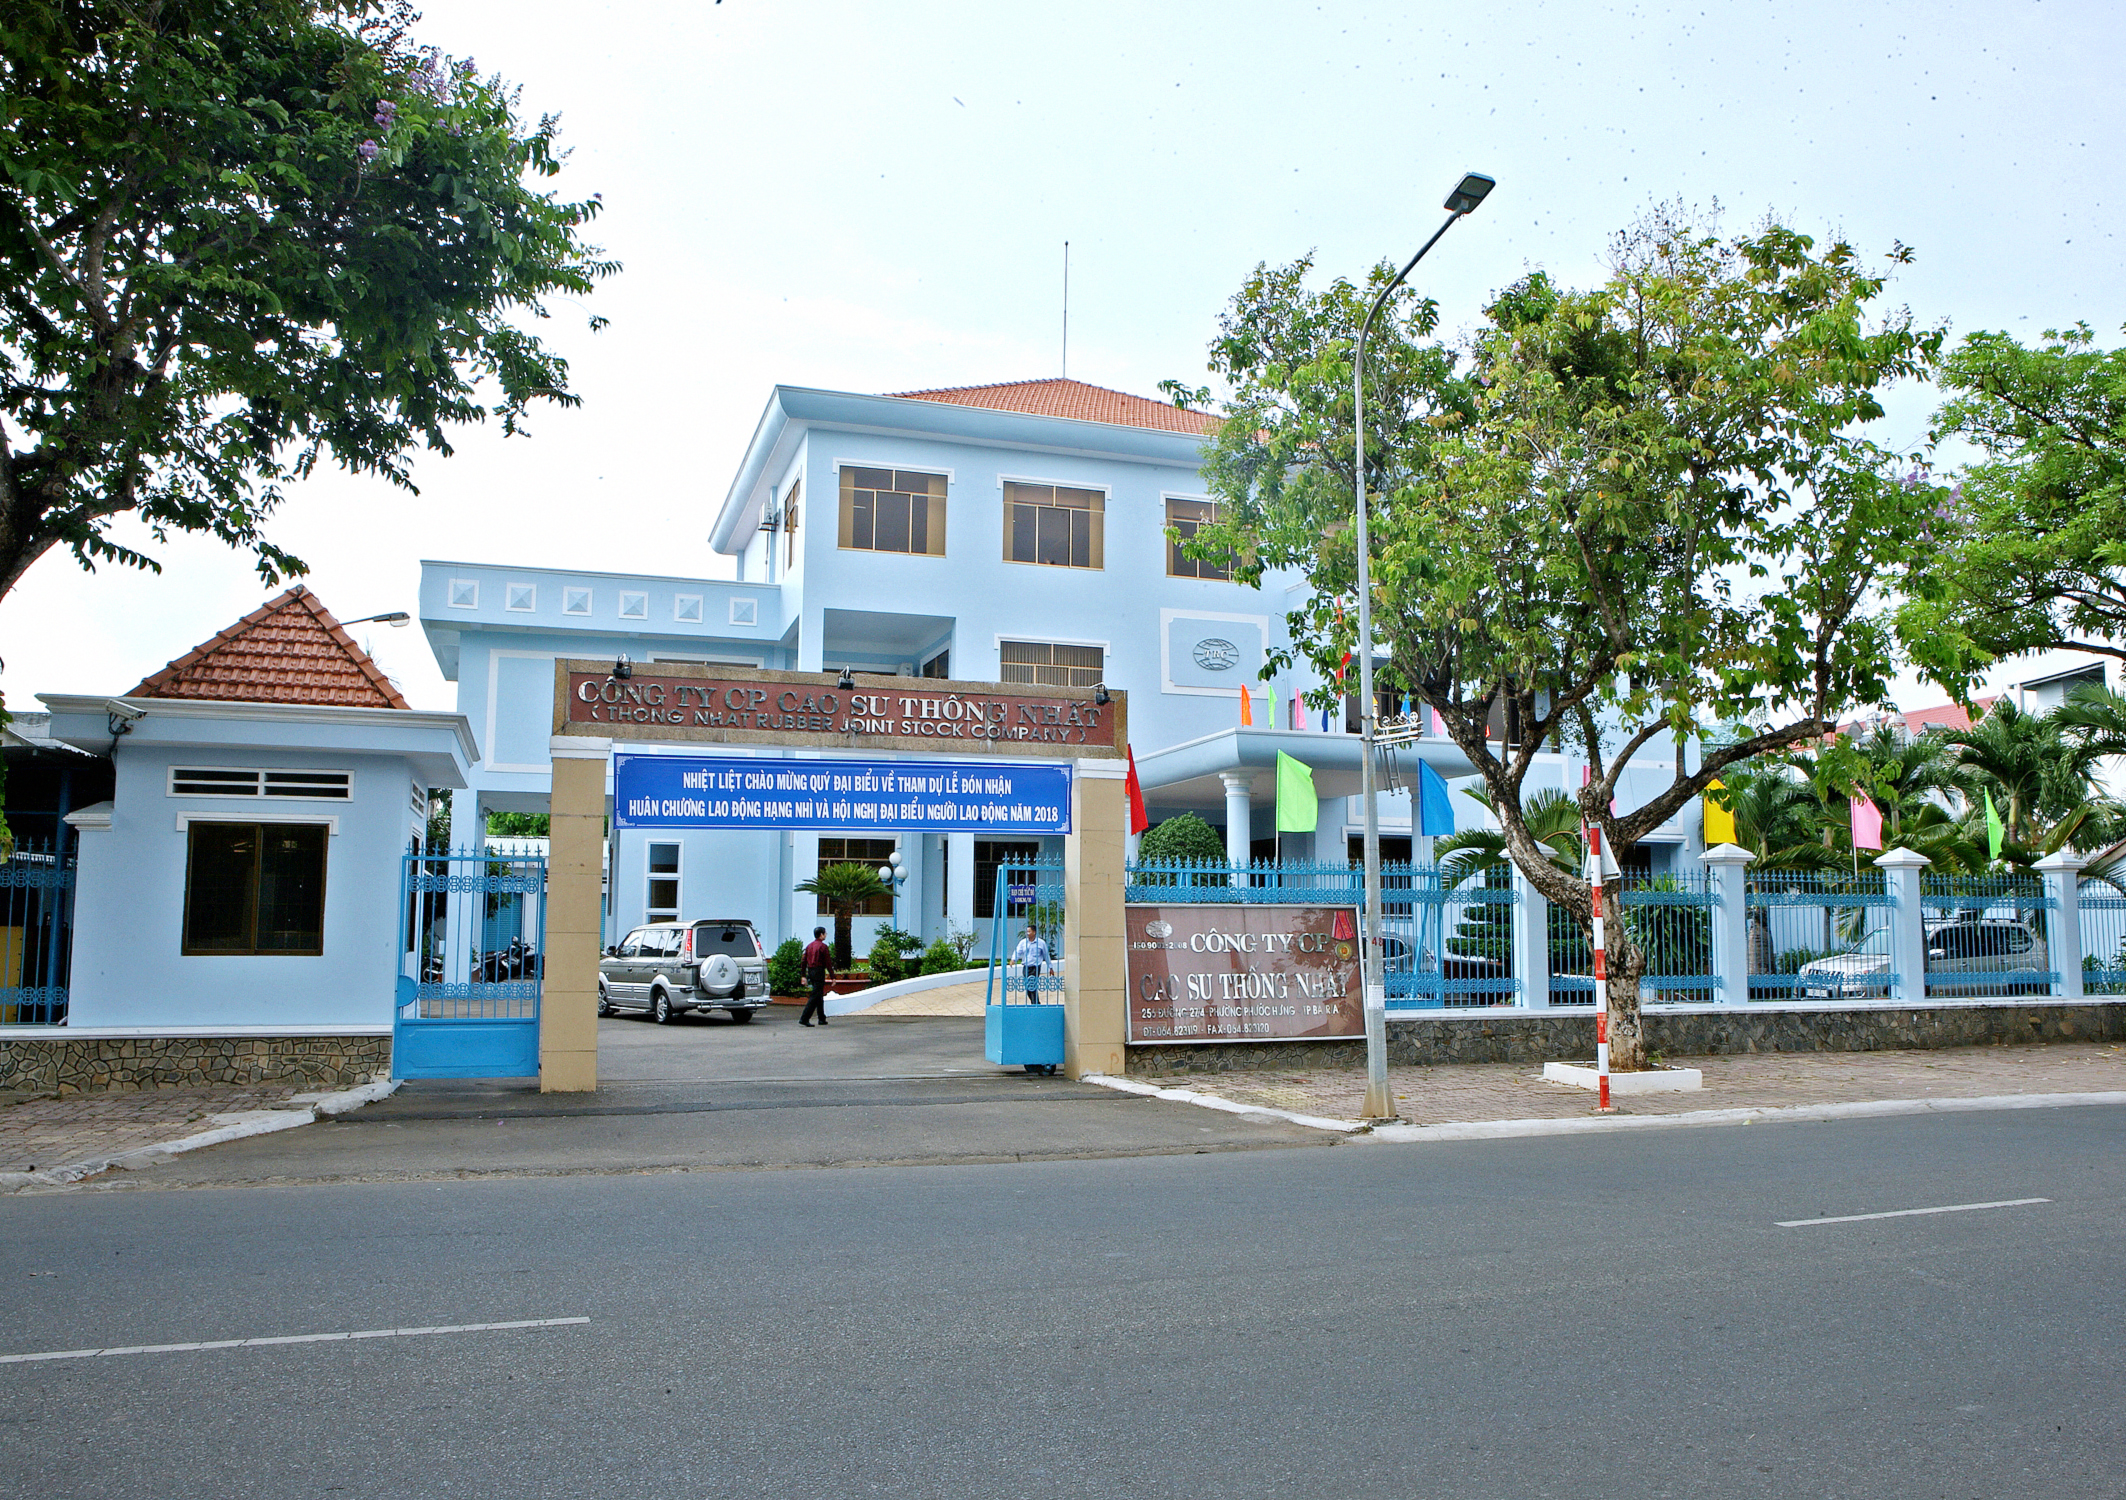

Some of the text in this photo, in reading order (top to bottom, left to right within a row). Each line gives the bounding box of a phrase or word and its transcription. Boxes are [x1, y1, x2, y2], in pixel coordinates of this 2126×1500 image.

[1205, 650, 1228, 660] TRC
[577, 675, 667, 706] CÔNG
[674, 685, 717, 708] TY
[725, 688, 767, 711] CP
[777, 691, 840, 714] CAO
[850, 695, 889, 717] SU
[898, 694, 1008, 724] THỐNG
[694, 710, 750, 727] NHAT
[756, 712, 833, 731] RUBBER
[839, 717, 895, 734] JOINT
[901, 720, 964, 738] STOCK
[971, 724, 1070, 742] COMPANY
[683, 768, 1011, 797] NHIỆT LIỆT CHÀO MỪNG QUÝ ĐẠI BIỂU VỀ THAM DỰ LỄ ĐÓN NHẬN
[629, 795, 1058, 824] HUÂN CHƯƠNG LAO ĐỘNG HẠNG NHÌ VÀ HỘI NGHỊ ĐẠI BIỂU NGƯỜI LAO ĐỘNG NĂM 2018
[1147, 941, 1188, 949] 9001:208
[1190, 927, 1257, 953] CÔNG
[1261, 933, 1293, 953] TY
[1298, 932, 1331, 952] CP
[1141, 973, 1180, 1001] CAO
[1187, 973, 1213, 1000] SU
[1219, 961, 1288, 999] THỐNG
[1209, 1003, 1242, 1018] PHƯỜNG
[1244, 1002, 1271, 1016] PHƯỚC
